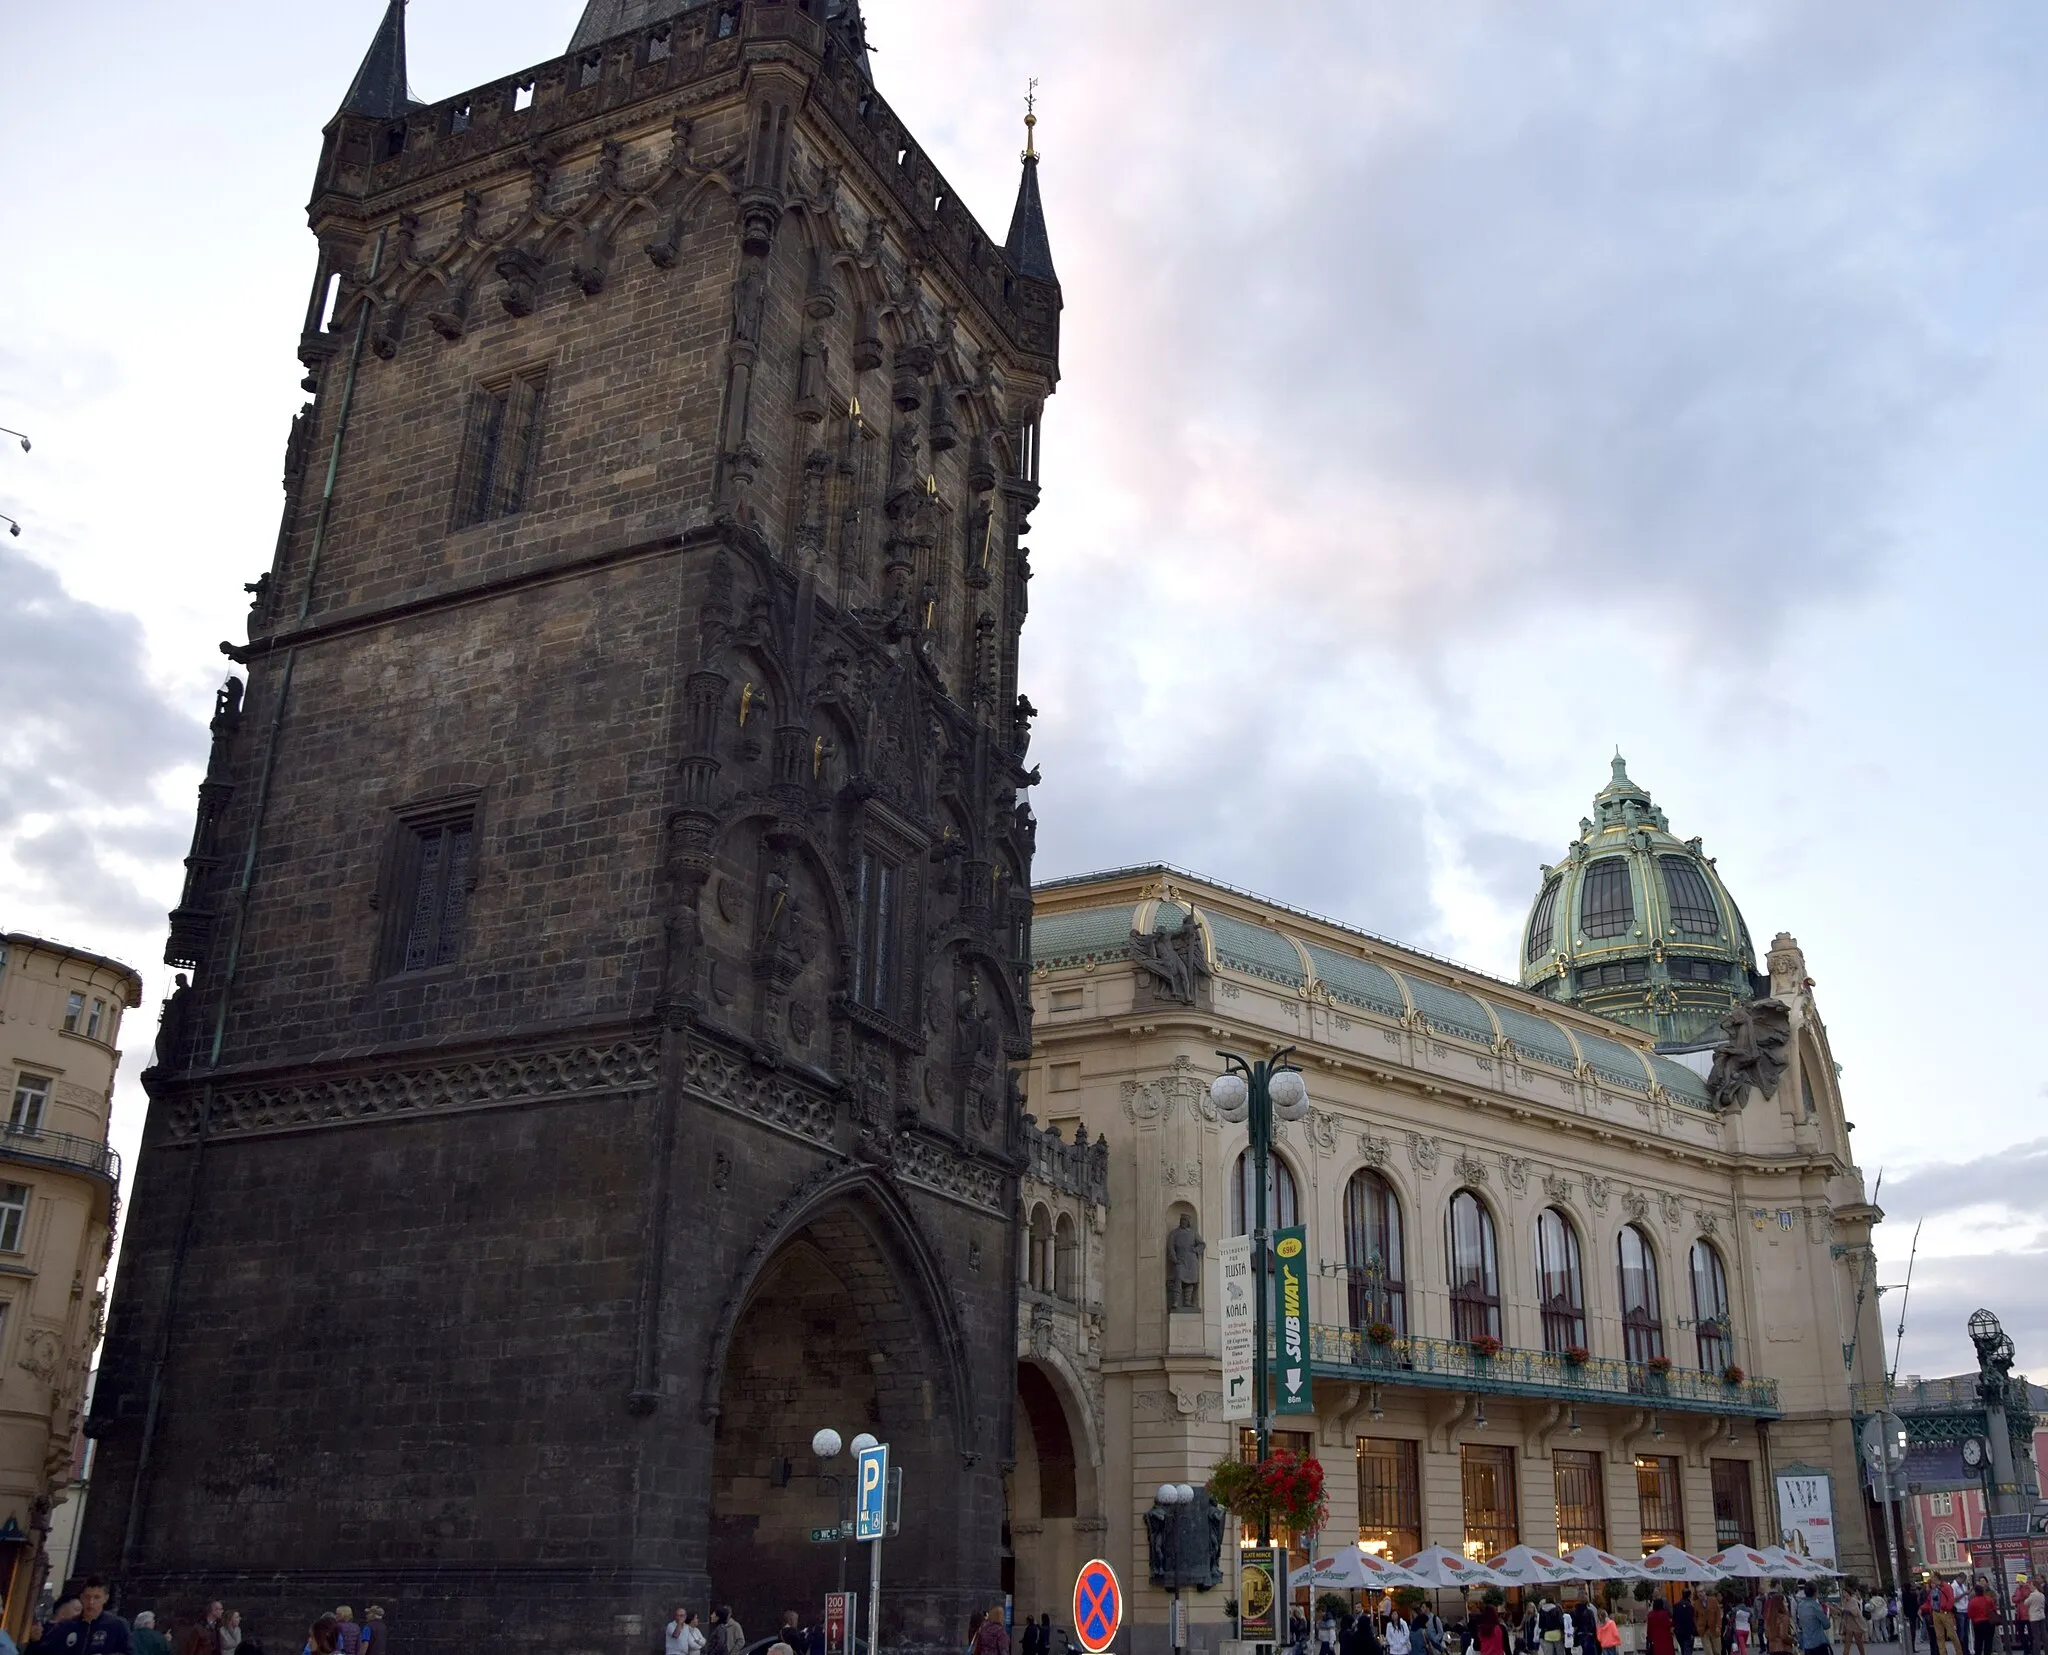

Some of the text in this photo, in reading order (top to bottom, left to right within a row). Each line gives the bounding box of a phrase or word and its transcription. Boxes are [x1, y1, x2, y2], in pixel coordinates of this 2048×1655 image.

[1226, 1303, 1247, 1318] KOALA
[1282, 1264, 1302, 1363] SUBWAY
[863, 1459, 879, 1511] P
[820, 1529, 831, 1538] WC
[828, 1596, 843, 1607] 200
